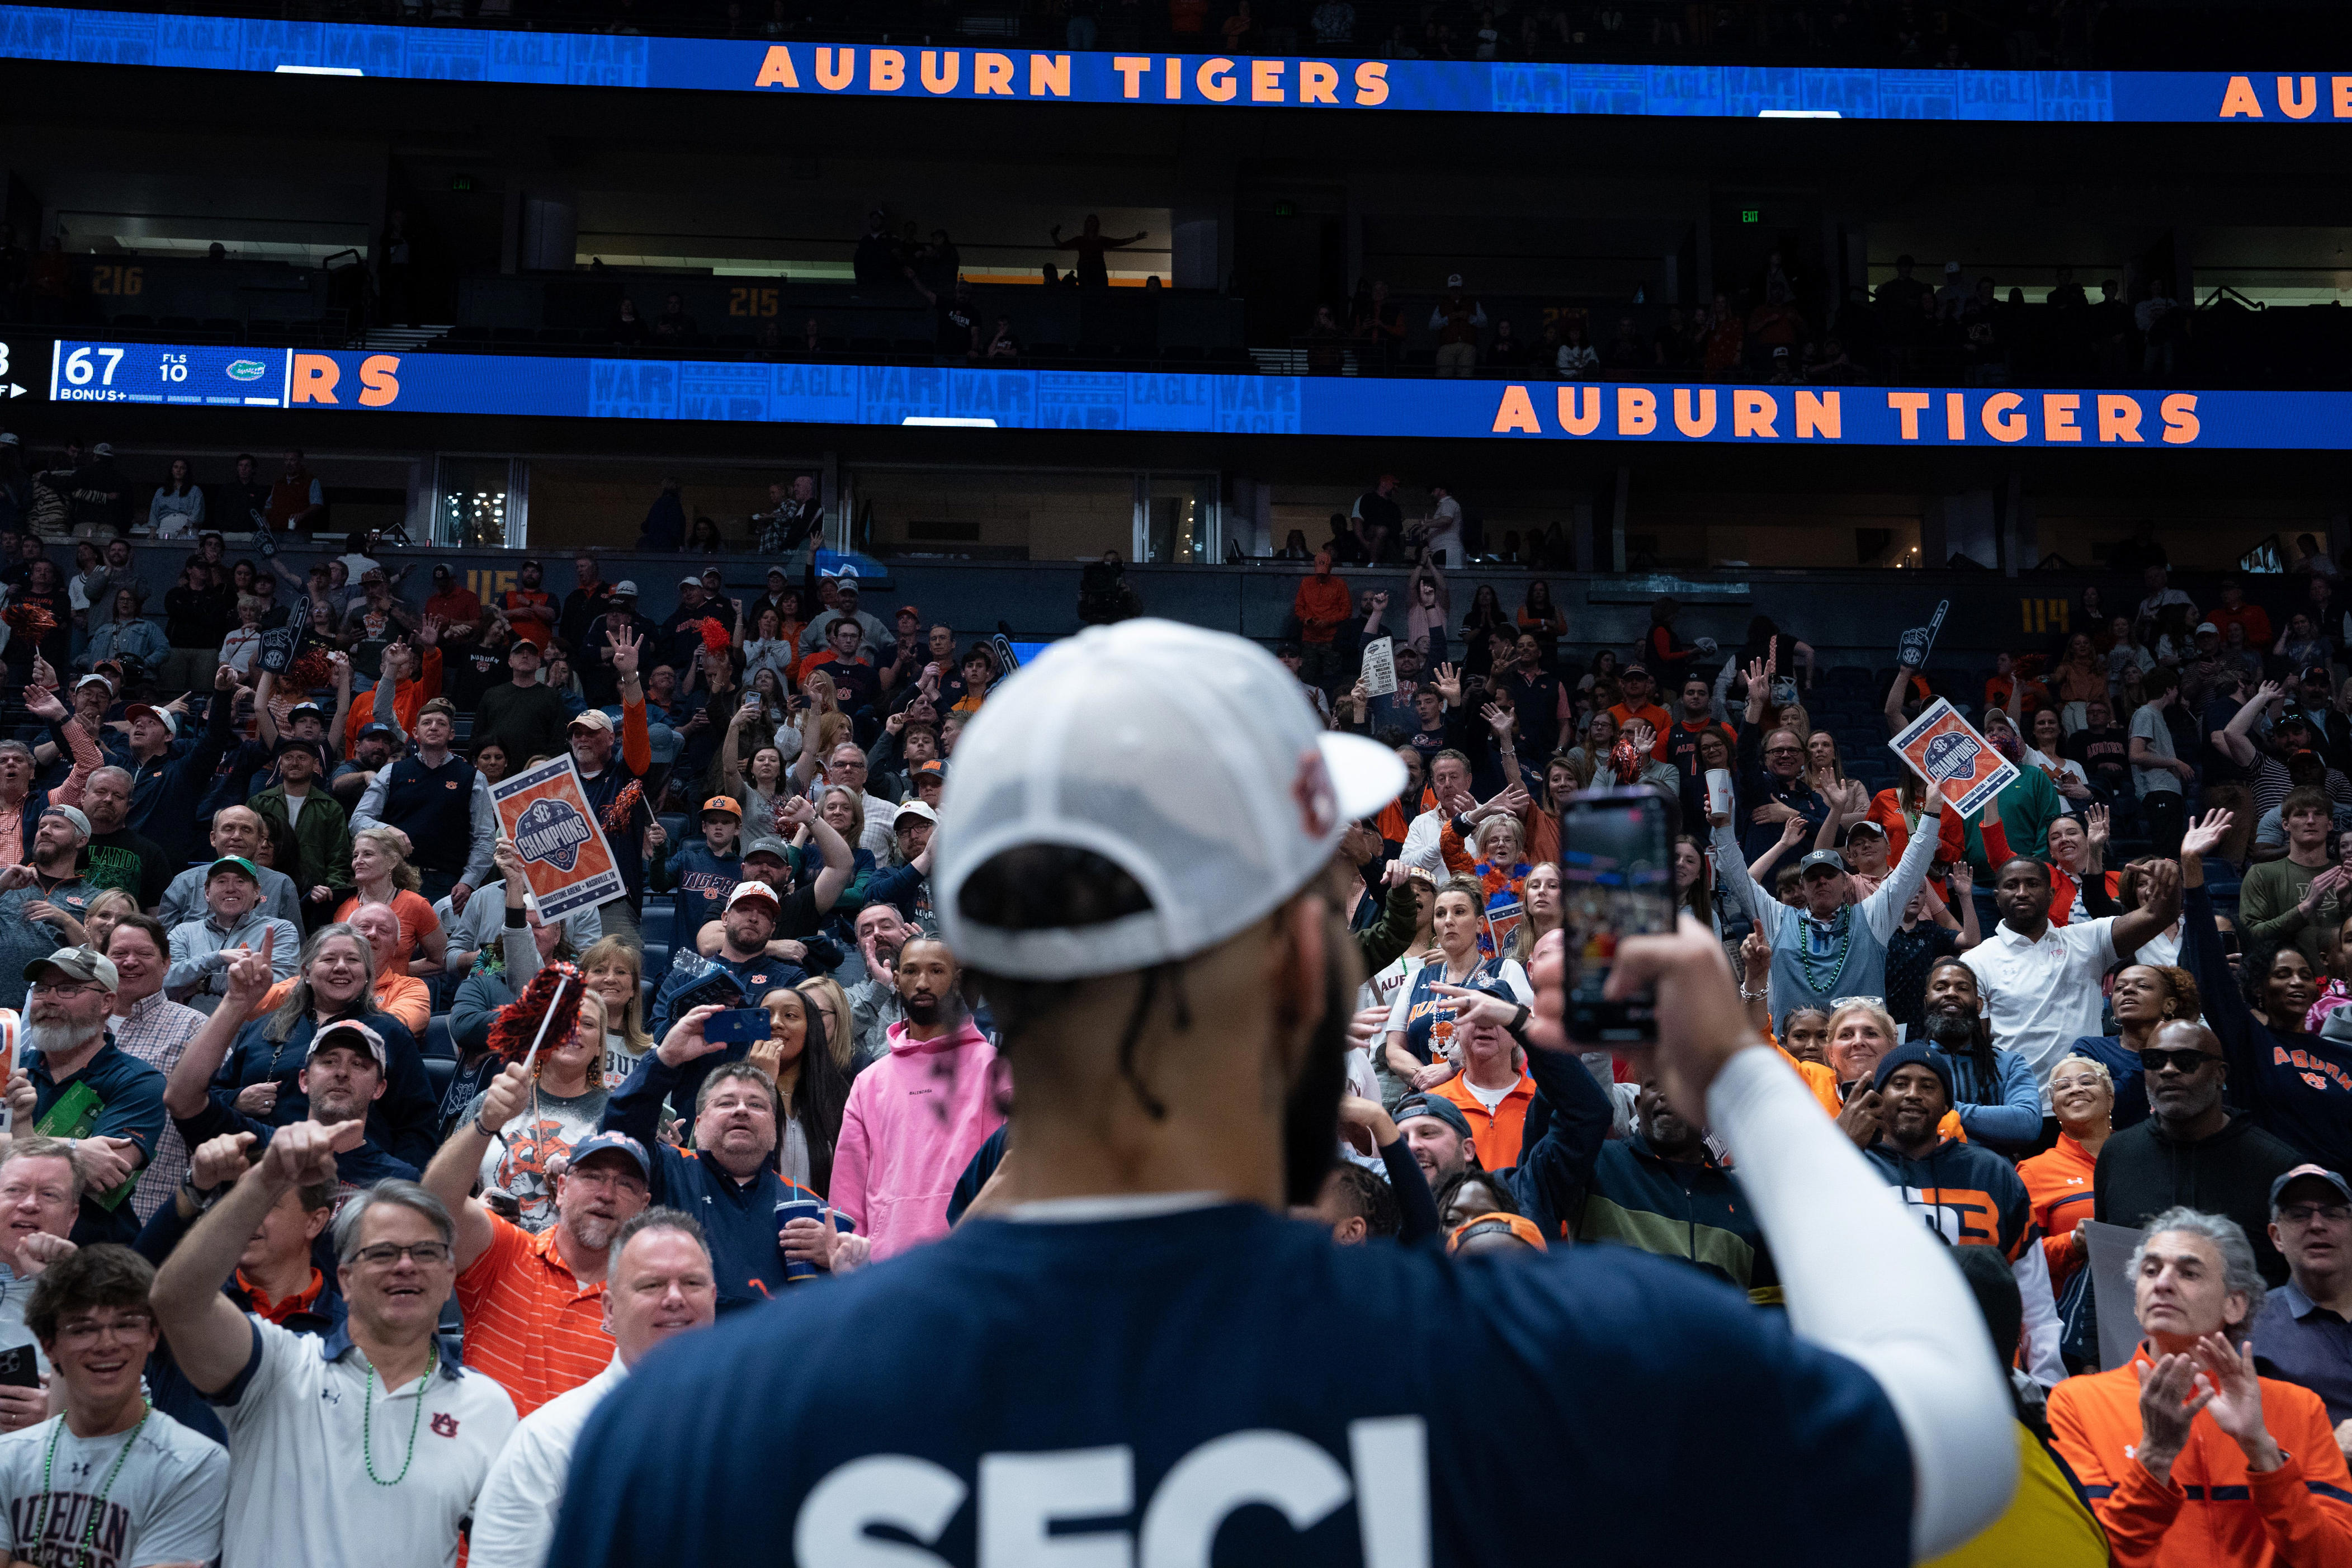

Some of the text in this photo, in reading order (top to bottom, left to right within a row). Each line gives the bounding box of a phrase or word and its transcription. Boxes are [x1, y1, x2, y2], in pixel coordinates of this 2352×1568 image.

[755, 45, 1389, 106] AUBURN TIGERS
[1742, 210, 1759, 224] EXIT
[92, 266, 143, 295] 216
[729, 287, 778, 317] 215
[64, 348, 124, 386] 67
[162, 353, 187, 363] FLS
[159, 365, 187, 382] 10
[594, 364, 673, 402] WAR
[777, 366, 852, 396] EAGLE
[60, 388, 127, 401] BONUS+
[1220, 376, 1296, 413] WAR
[1493, 385, 2201, 444] AUBURN TIGERS
[467, 569, 518, 606] 115
[2020, 598, 2070, 634] 114
[266, 651, 284, 667] SEC
[471, 654, 499, 664] AUBURN
[1903, 648, 1920, 663] SEC
[1675, 743, 1697, 755] AUB
[1929, 737, 1978, 780] CHAMPIONS
[1933, 739, 1948, 753] SEC
[2087, 741, 2126, 760] AUBURN
[1956, 790, 1976, 809] BRIDGESTONE
[1976, 783, 1986, 795] ARENA
[532, 803, 551, 823] SEC
[517, 815, 588, 861] CHAMPIONS
[88, 844, 135, 869] LAND
[538, 871, 616, 907] BRIDGESTONE ARENA NASHVILLE, TN
[2273, 1046, 2352, 1091] ABURN
[12, 1492, 130, 1560] AUBURN
